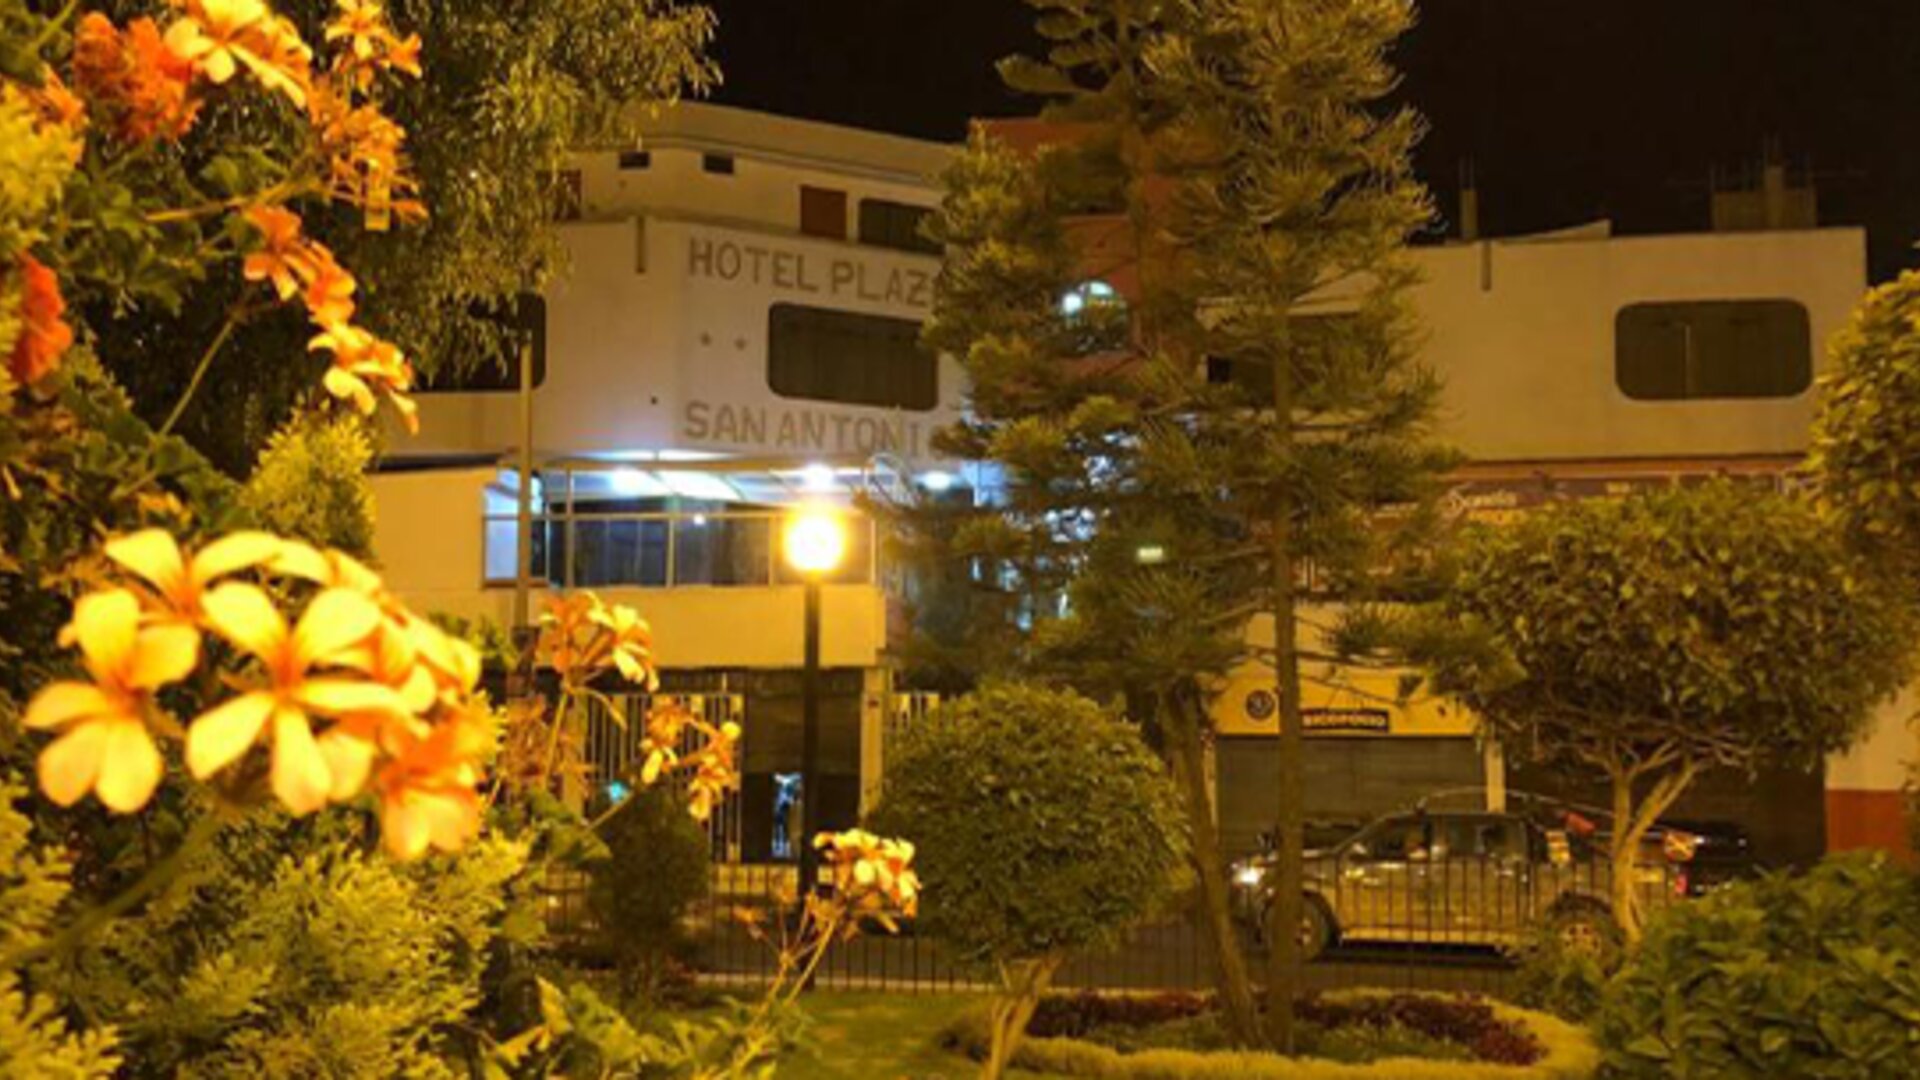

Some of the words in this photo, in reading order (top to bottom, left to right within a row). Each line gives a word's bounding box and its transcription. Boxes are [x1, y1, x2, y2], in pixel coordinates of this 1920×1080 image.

[689, 239, 819, 293] HOTEL
[829, 261, 932, 307] PLAZ
[684, 401, 767, 444] SAN
[775, 411, 921, 457] ANTONI
